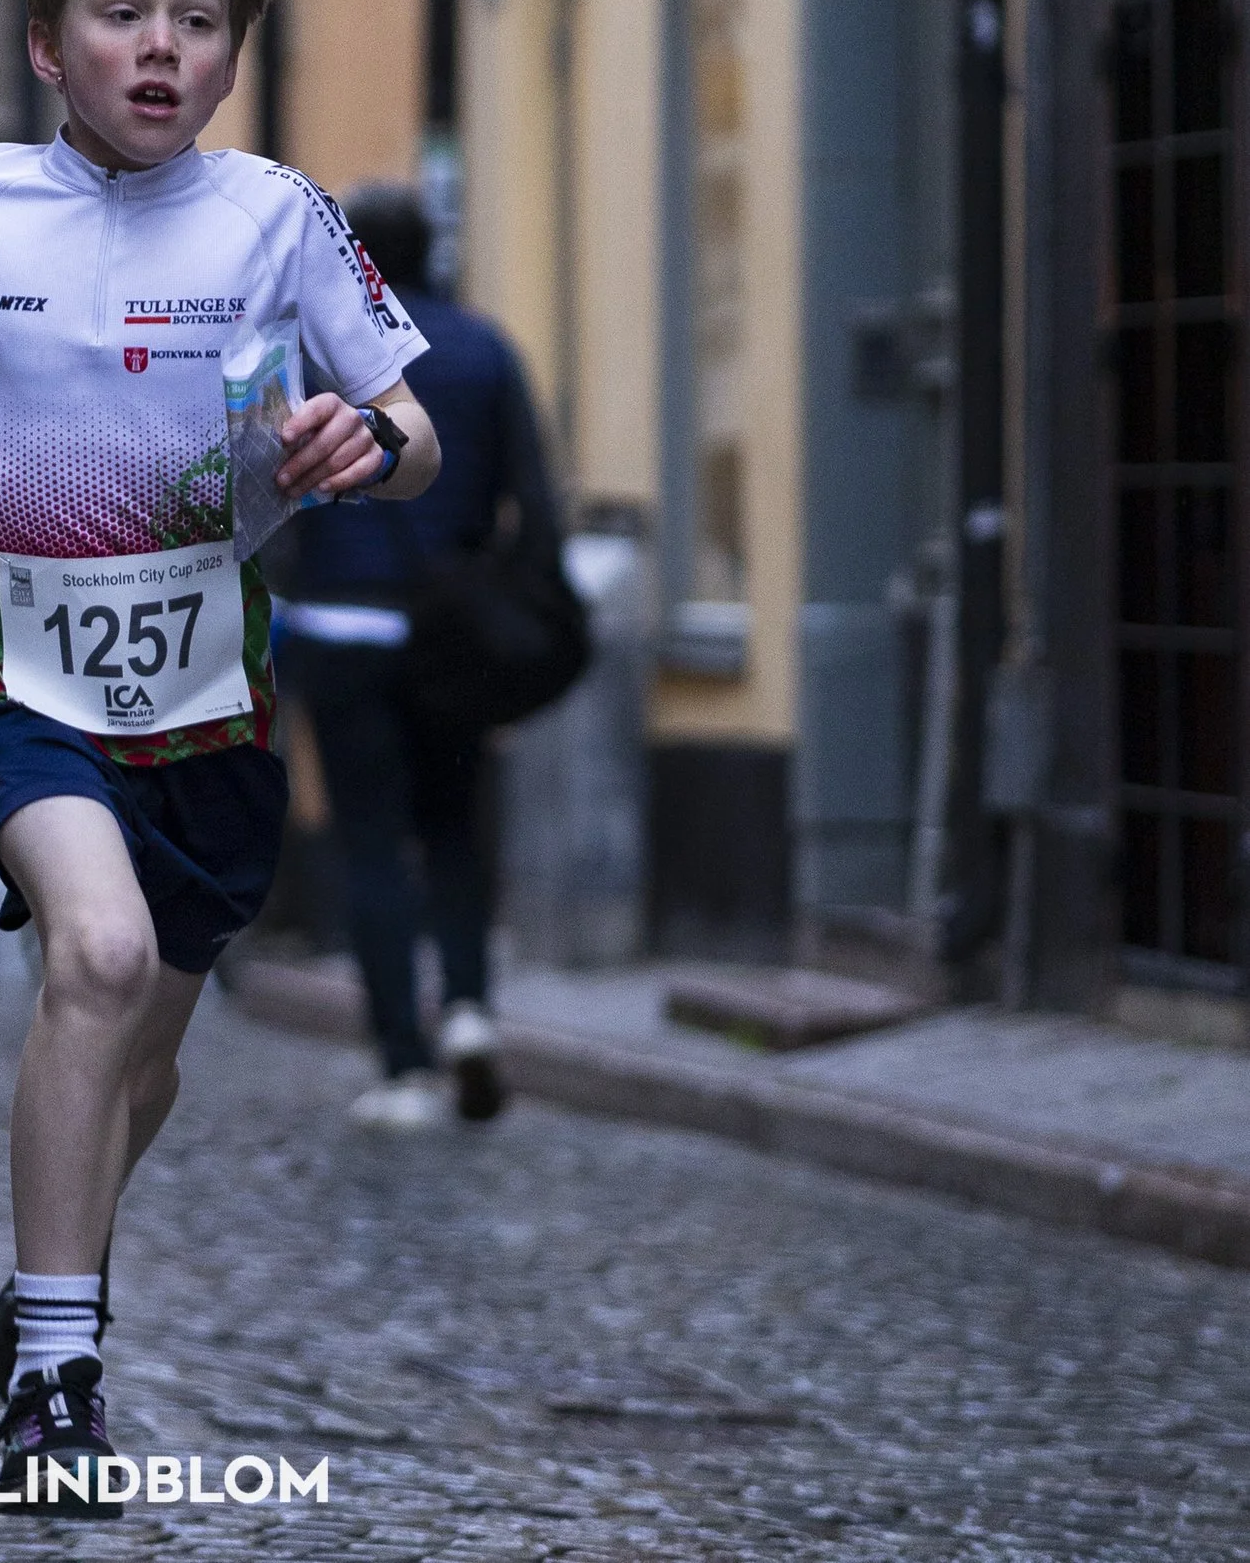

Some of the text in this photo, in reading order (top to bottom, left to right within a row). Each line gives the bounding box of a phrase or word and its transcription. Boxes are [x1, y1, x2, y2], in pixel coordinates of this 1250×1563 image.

[264, 169, 338, 239] MOUNTAIN
[125, 297, 247, 314] TULLINGE SK
[172, 314, 233, 325] BOTKYRKA
[150, 349, 222, 359] BOTKYRKA KO
[62, 555, 223, 587] Stockholm City Cup 2025
[43, 591, 205, 679] 1257
[104, 684, 154, 709] ICA
[129, 708, 155, 718] nära
[107, 717, 155, 727] Järvastaden
